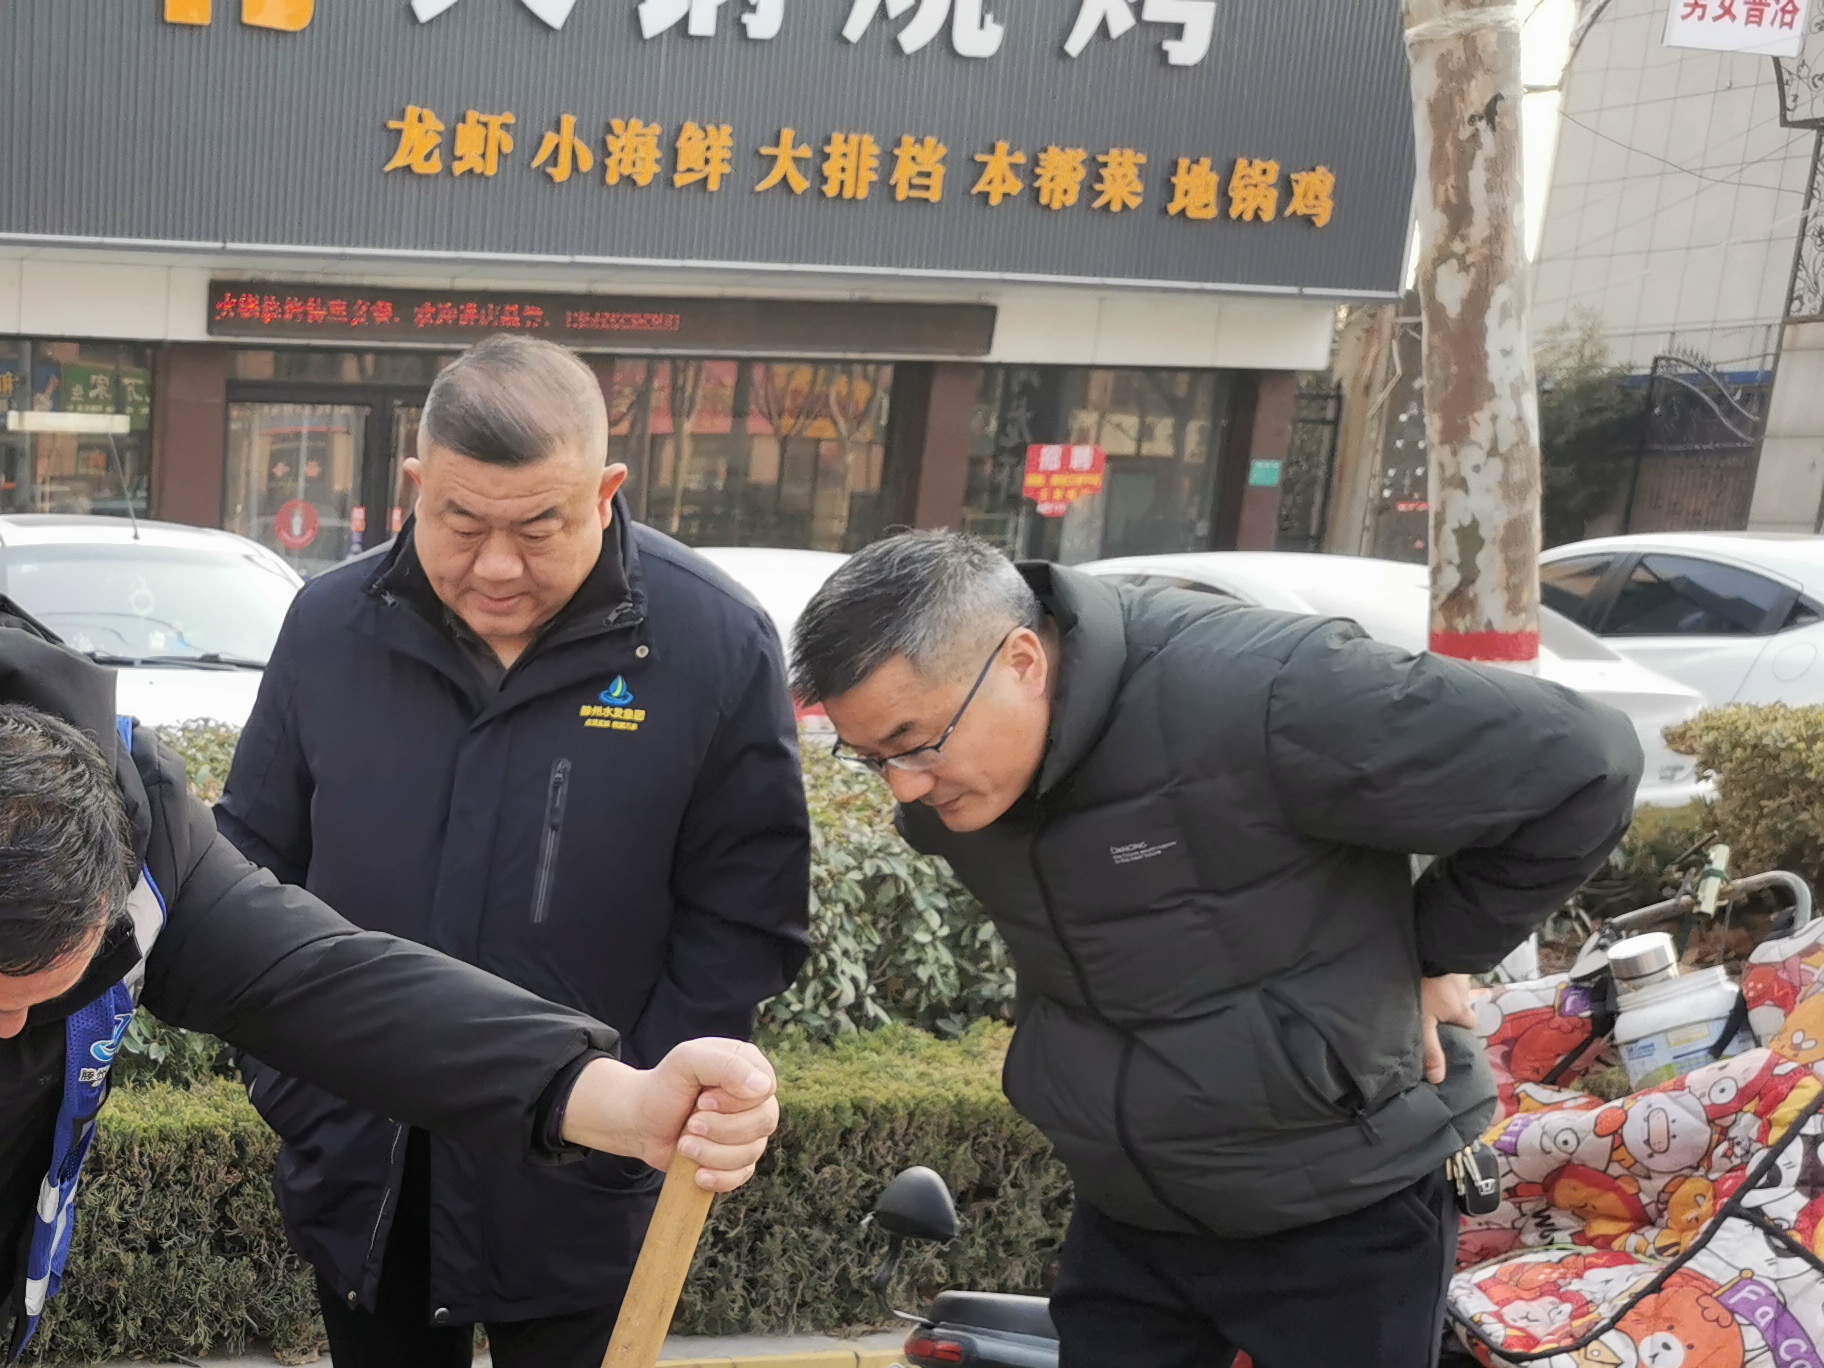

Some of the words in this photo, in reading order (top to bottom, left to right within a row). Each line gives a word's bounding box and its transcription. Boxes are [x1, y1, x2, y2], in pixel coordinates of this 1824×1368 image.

[382, 104, 517, 177] 龙虾
[530, 113, 734, 192] 小海鲜
[753, 126, 948, 203] 大排档
[970, 139, 1147, 212] 本帮菜
[1166, 156, 1336, 228] 地锅鸡
